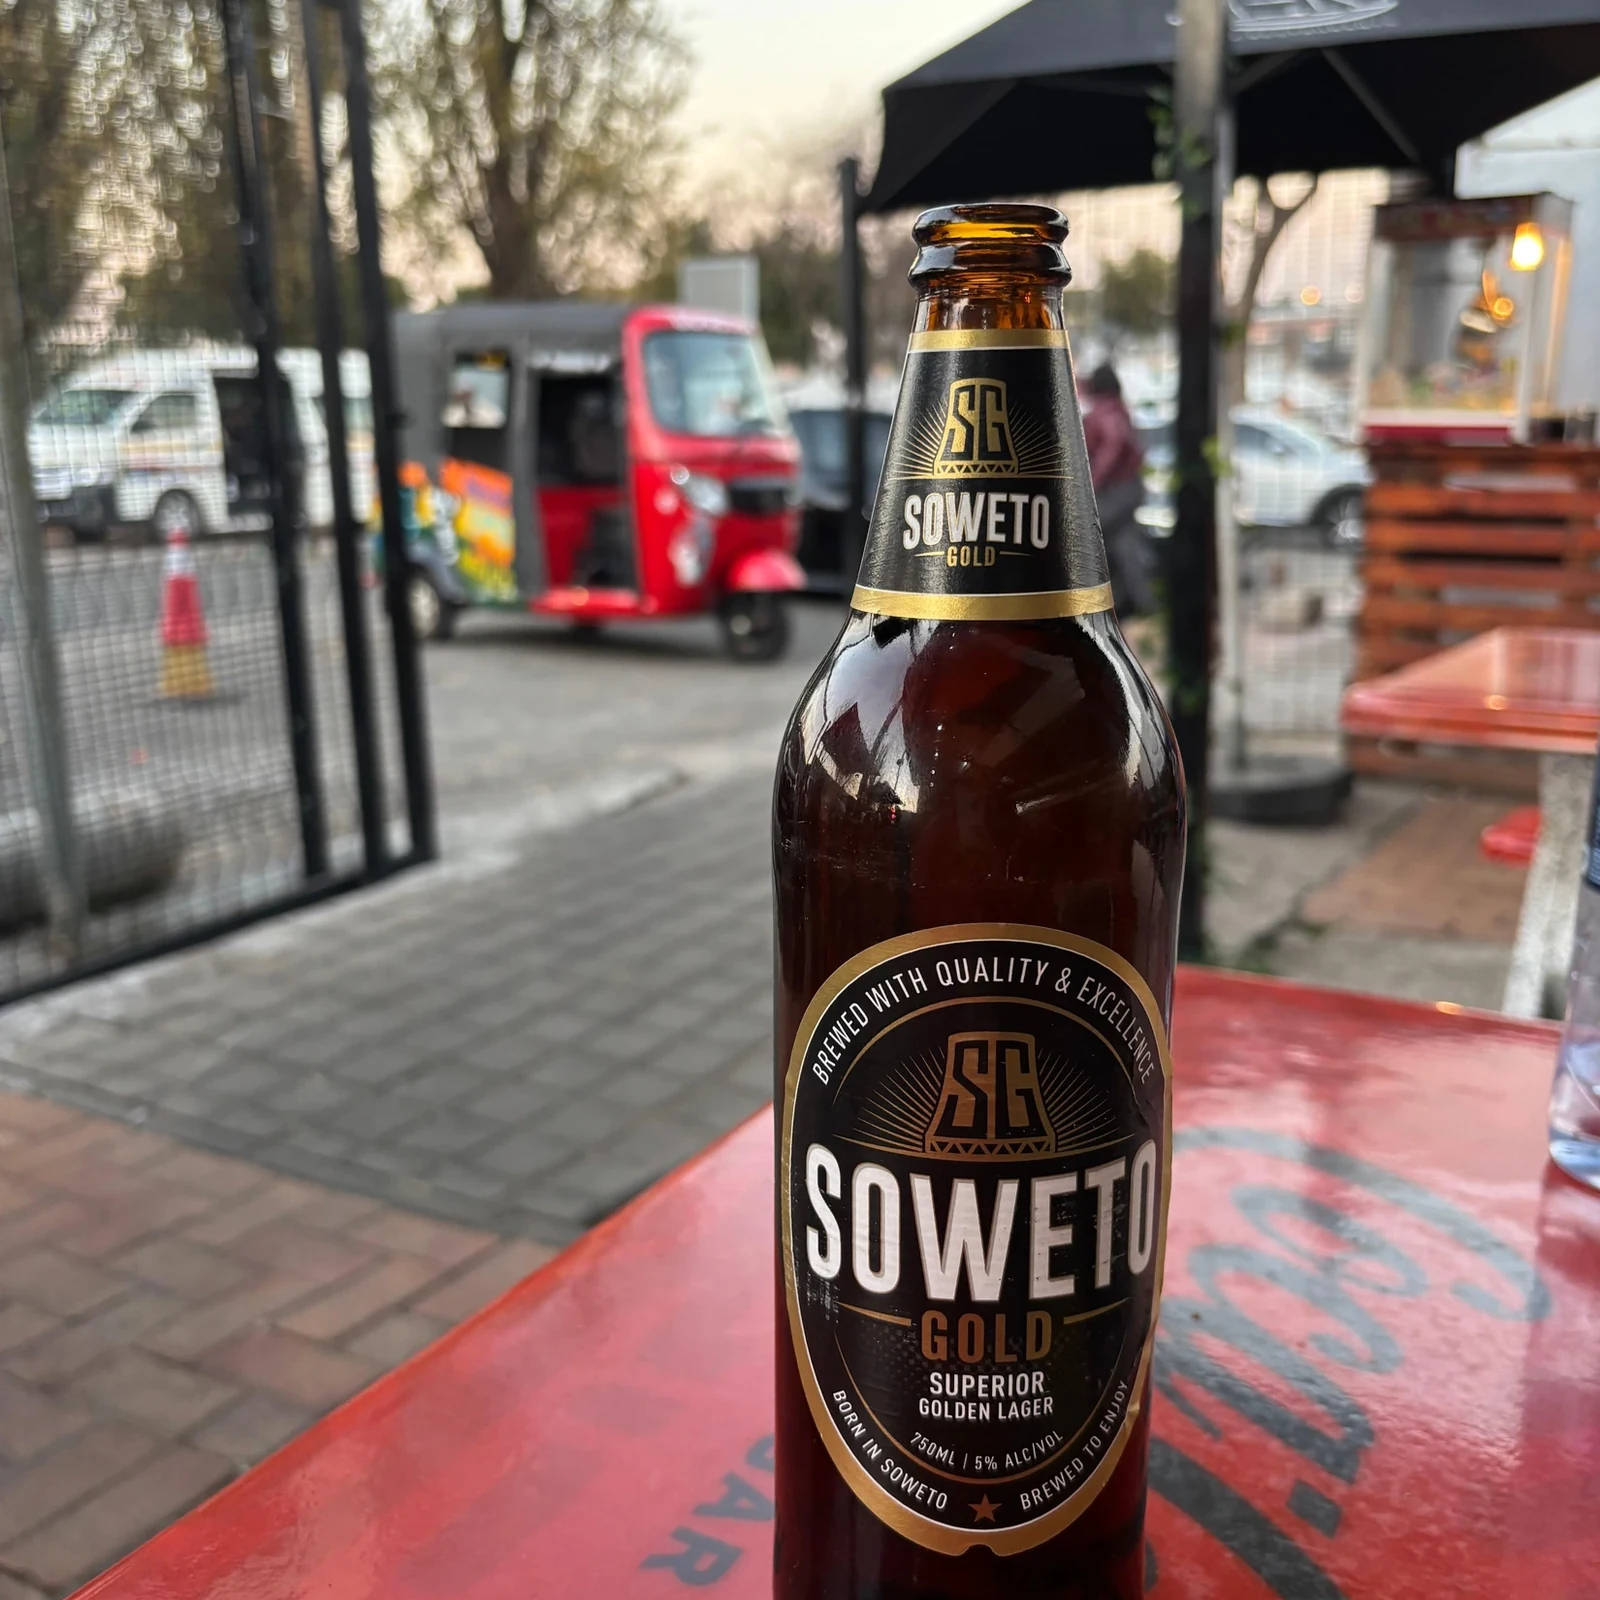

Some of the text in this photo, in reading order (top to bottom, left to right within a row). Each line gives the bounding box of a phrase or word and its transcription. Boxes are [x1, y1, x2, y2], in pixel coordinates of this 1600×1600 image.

[902, 492, 1050, 550] SOWETO
[946, 546, 996, 567] GOLD
[812, 957, 1155, 1086] BREWED WITH QUALITY & EXCELLENCE
[805, 1143, 1156, 1301] SOWETO
[921, 1310, 1053, 1364] GOLD
[919, 1396, 1054, 1421] GOLDEN LAGER
[929, 1370, 1047, 1398] SUPERIOR
[832, 1389, 948, 1511] BORN IN SOWETO
[910, 1431, 956, 1467] 750ML
[974, 1454, 998, 1471] 5%
[1005, 1430, 1064, 1469] ALC/VOL
[1019, 1379, 1129, 1512] BREWED TO ENJOY
